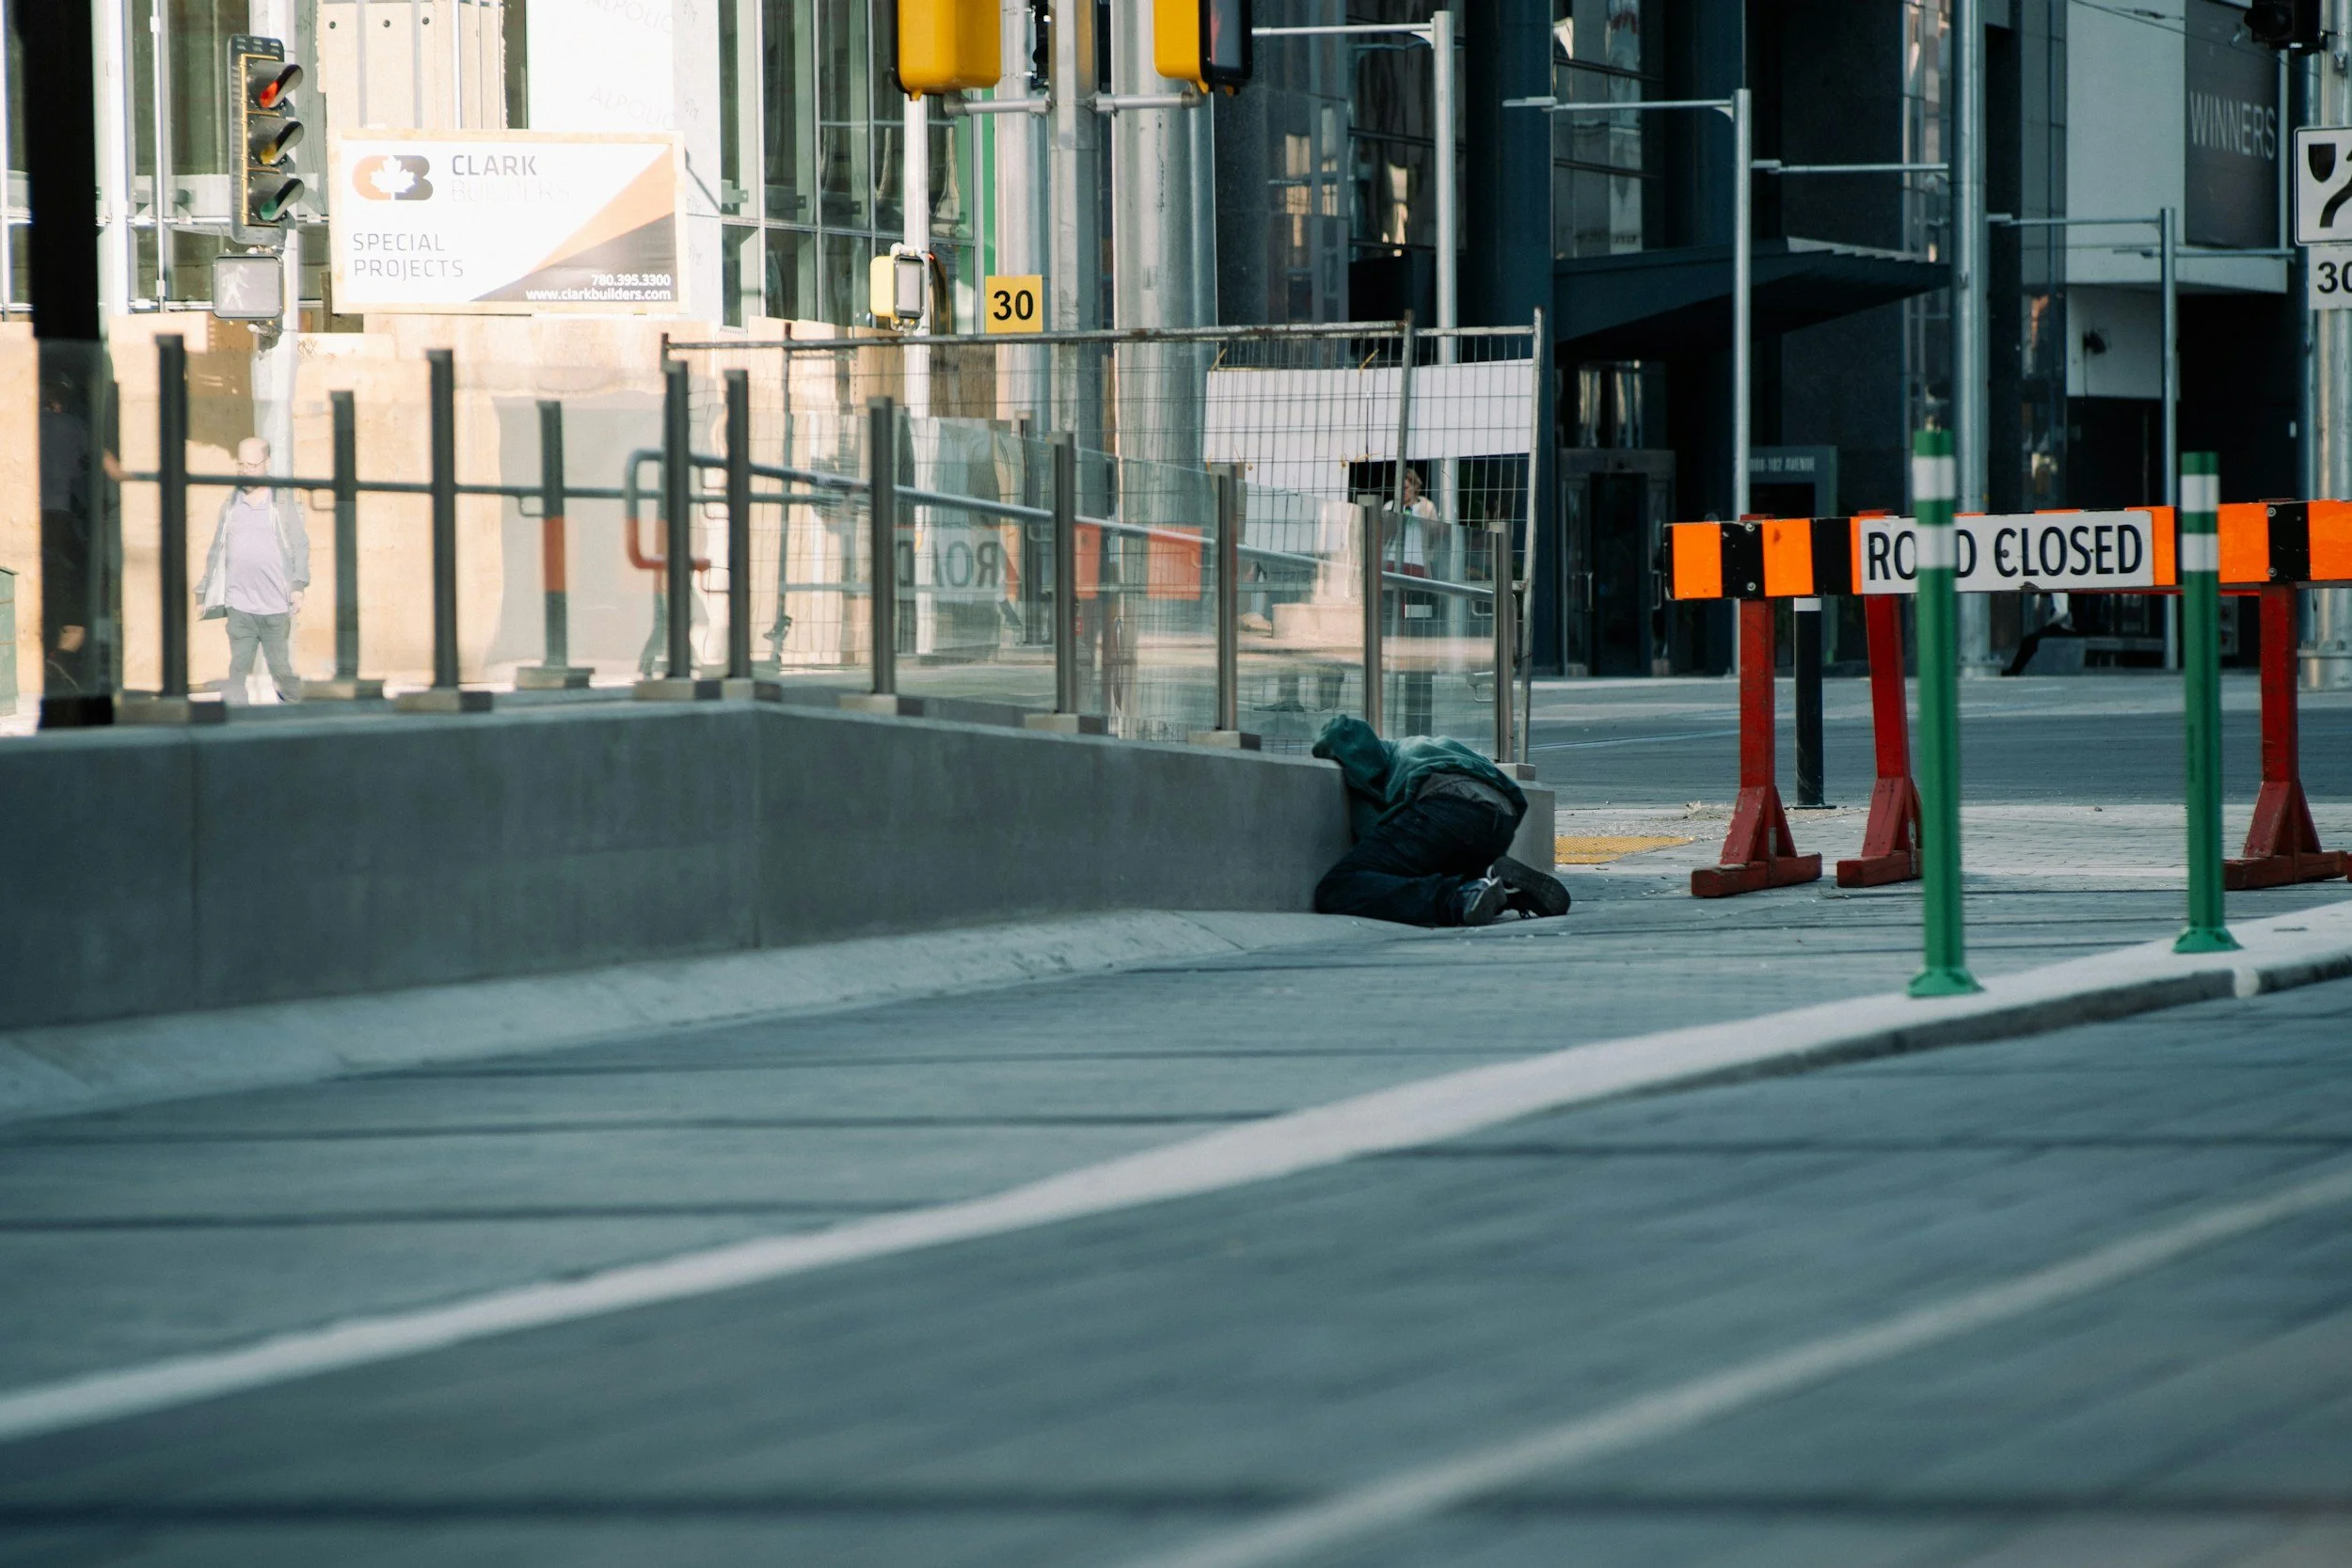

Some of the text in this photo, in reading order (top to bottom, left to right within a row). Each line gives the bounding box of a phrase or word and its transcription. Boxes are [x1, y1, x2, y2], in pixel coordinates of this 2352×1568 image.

[2190, 91, 2276, 161] WINNERS
[451, 154, 538, 176] CLARK
[452, 179, 572, 203] BUILDERS
[353, 232, 445, 252] SPECIAL
[354, 259, 464, 281] PROJECTS
[592, 274, 671, 286] 780.395.3300
[526, 287, 671, 301] www.clarkbuilders.com
[993, 290, 1034, 321] 30
[1867, 524, 2143, 580] ROD CLOSED
